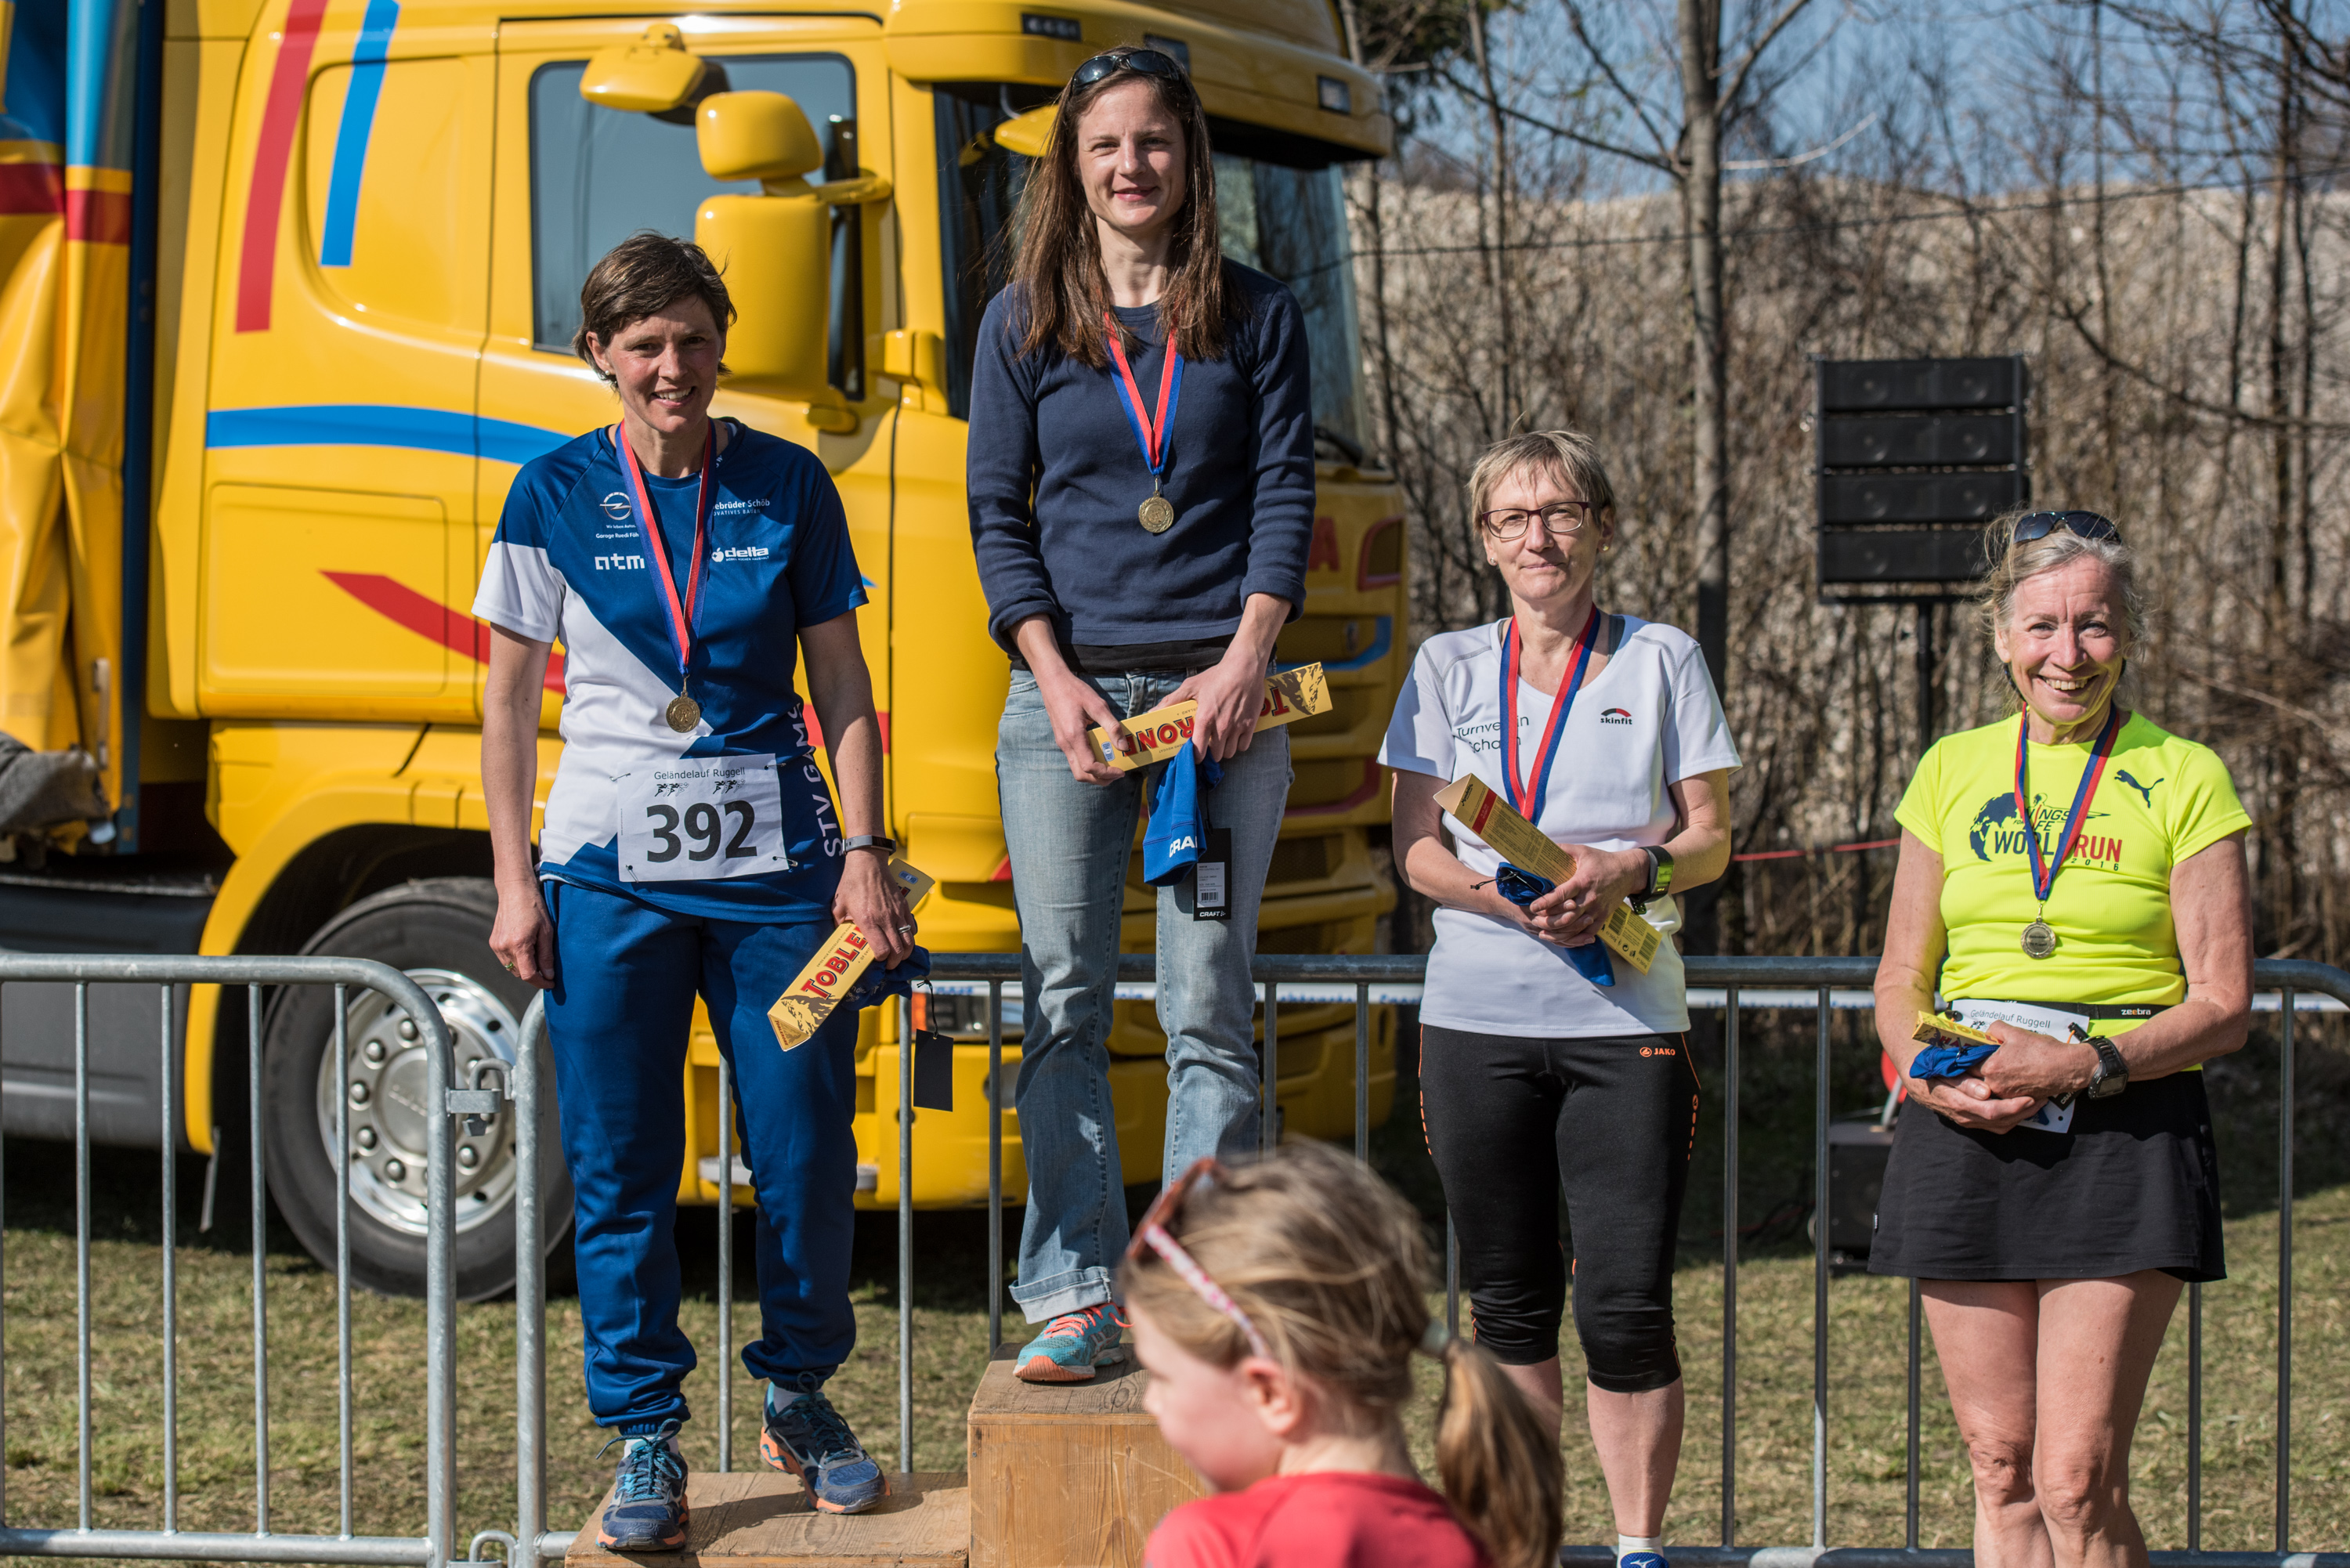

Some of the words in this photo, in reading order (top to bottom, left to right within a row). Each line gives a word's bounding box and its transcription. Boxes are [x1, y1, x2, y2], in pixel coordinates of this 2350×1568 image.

[713, 500, 745, 510] ebrüder
[747, 499, 770, 508] Schöb
[724, 547, 769, 558] delta
[1459, 716, 1529, 738] Turnvein
[654, 768, 710, 780] Geländelauf
[713, 767, 745, 779] Ruggell
[646, 800, 757, 862] 392
[812, 794, 844, 858] STV
[1169, 836, 1198, 858] CRA
[1994, 831, 2063, 856] WOL
[2073, 834, 2123, 862] RUN
[2071, 858, 2119, 872] 2016
[801, 927, 869, 1000] TOBLE
[1971, 1010, 2014, 1021] Geländelauf
[2016, 1015, 2051, 1028] Ruggell
